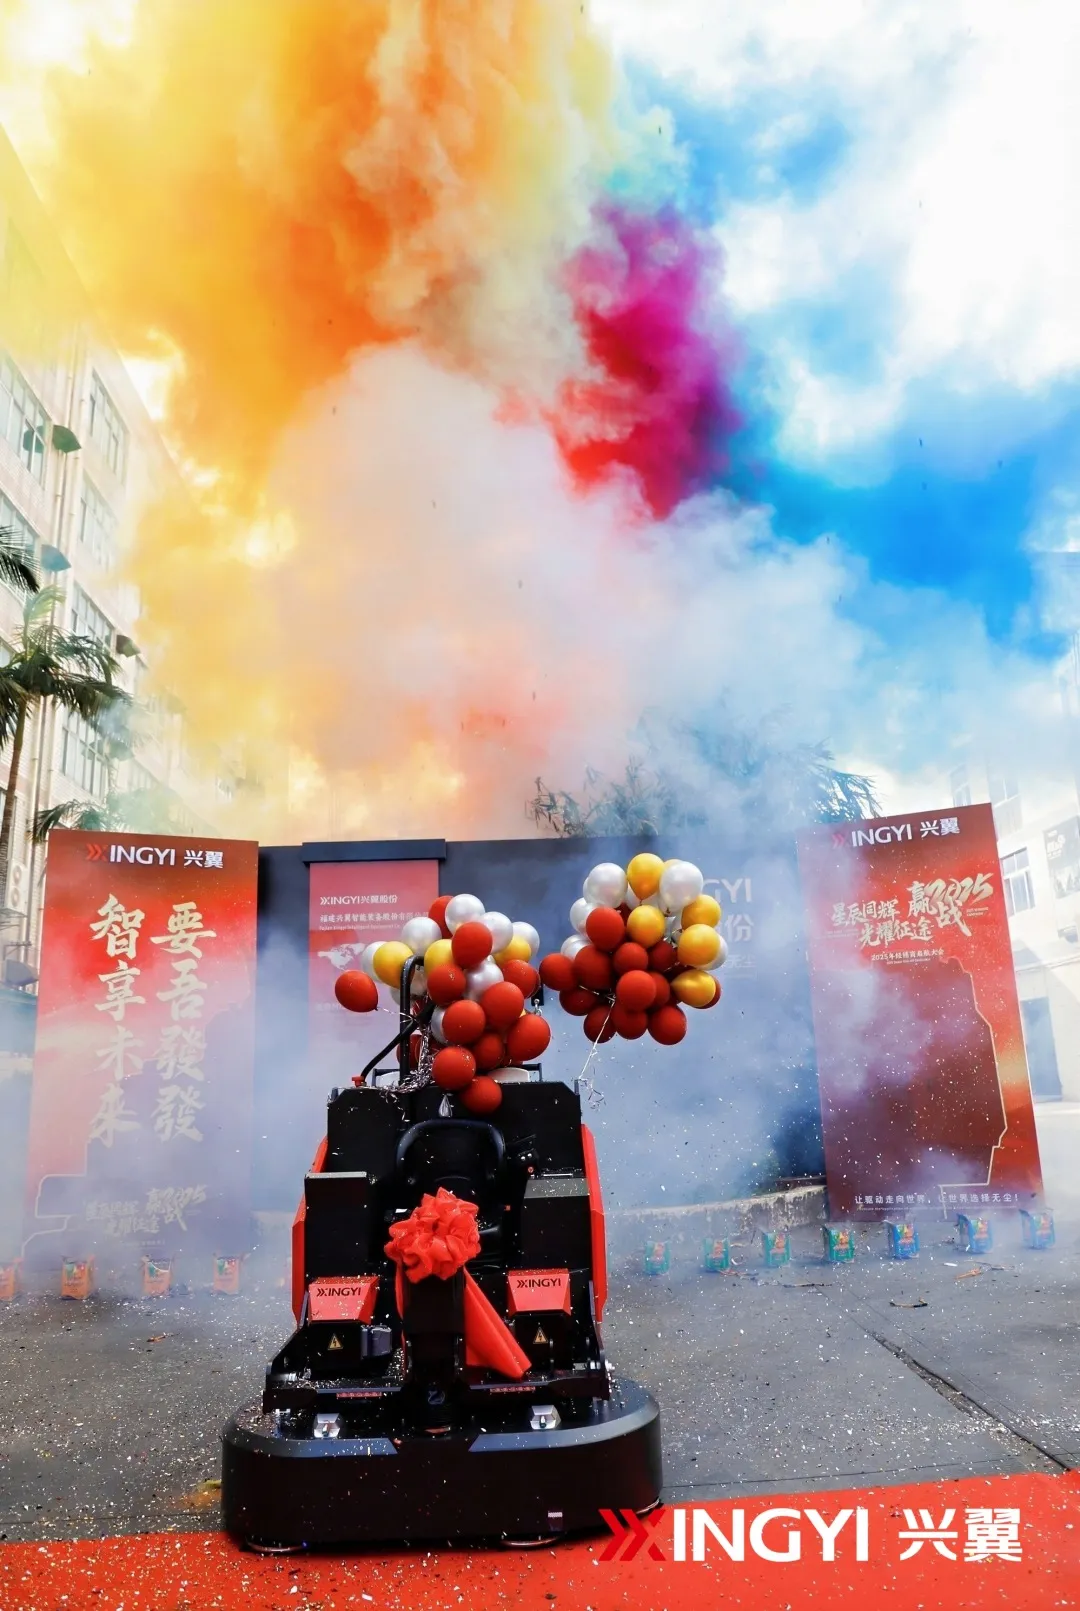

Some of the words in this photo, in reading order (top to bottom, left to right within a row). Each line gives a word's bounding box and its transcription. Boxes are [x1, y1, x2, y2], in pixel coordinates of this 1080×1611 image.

[920, 816, 960, 838] 兴翼
[184, 849, 224, 869] 兴翼
[722, 913, 755, 942] 份
[316, 1286, 362, 1298] XINGYI
[516, 1278, 561, 1289] XINGYI
